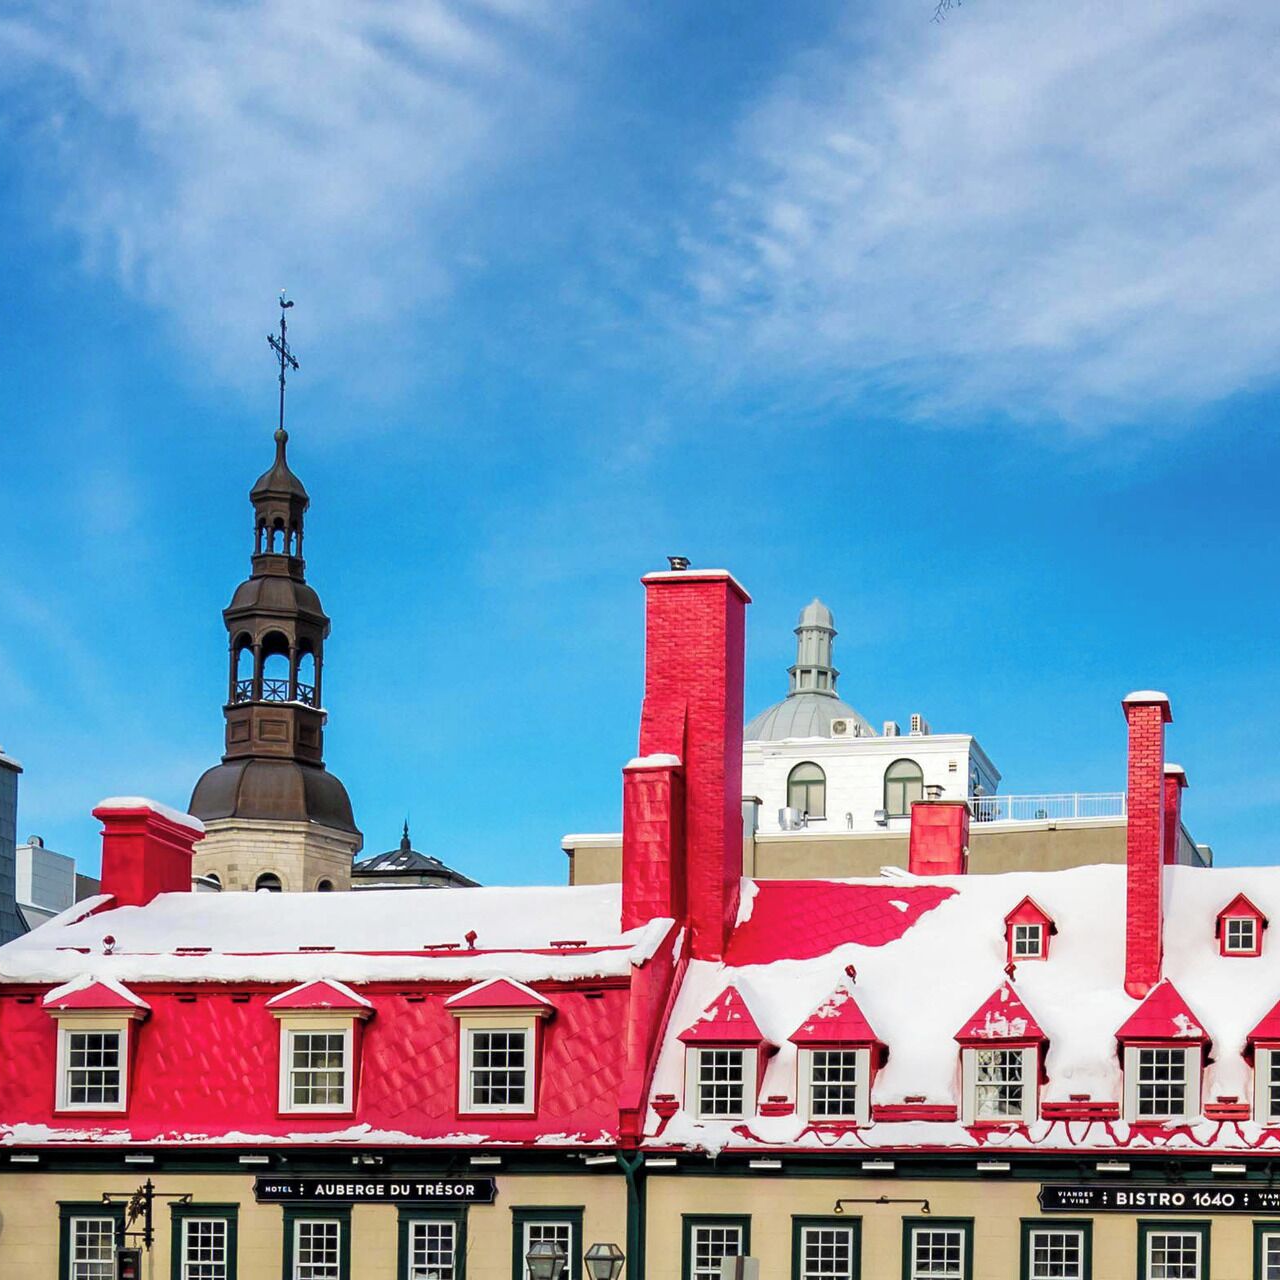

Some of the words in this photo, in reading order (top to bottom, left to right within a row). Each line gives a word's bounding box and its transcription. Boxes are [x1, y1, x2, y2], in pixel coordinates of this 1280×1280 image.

[314, 1184, 385, 1196] AUBERGE
[390, 1184, 410, 1196] DU
[415, 1181, 475, 1196] TRÉSOR
[1116, 1192, 1185, 1206] BISTRO
[1192, 1192, 1235, 1207] 1640
